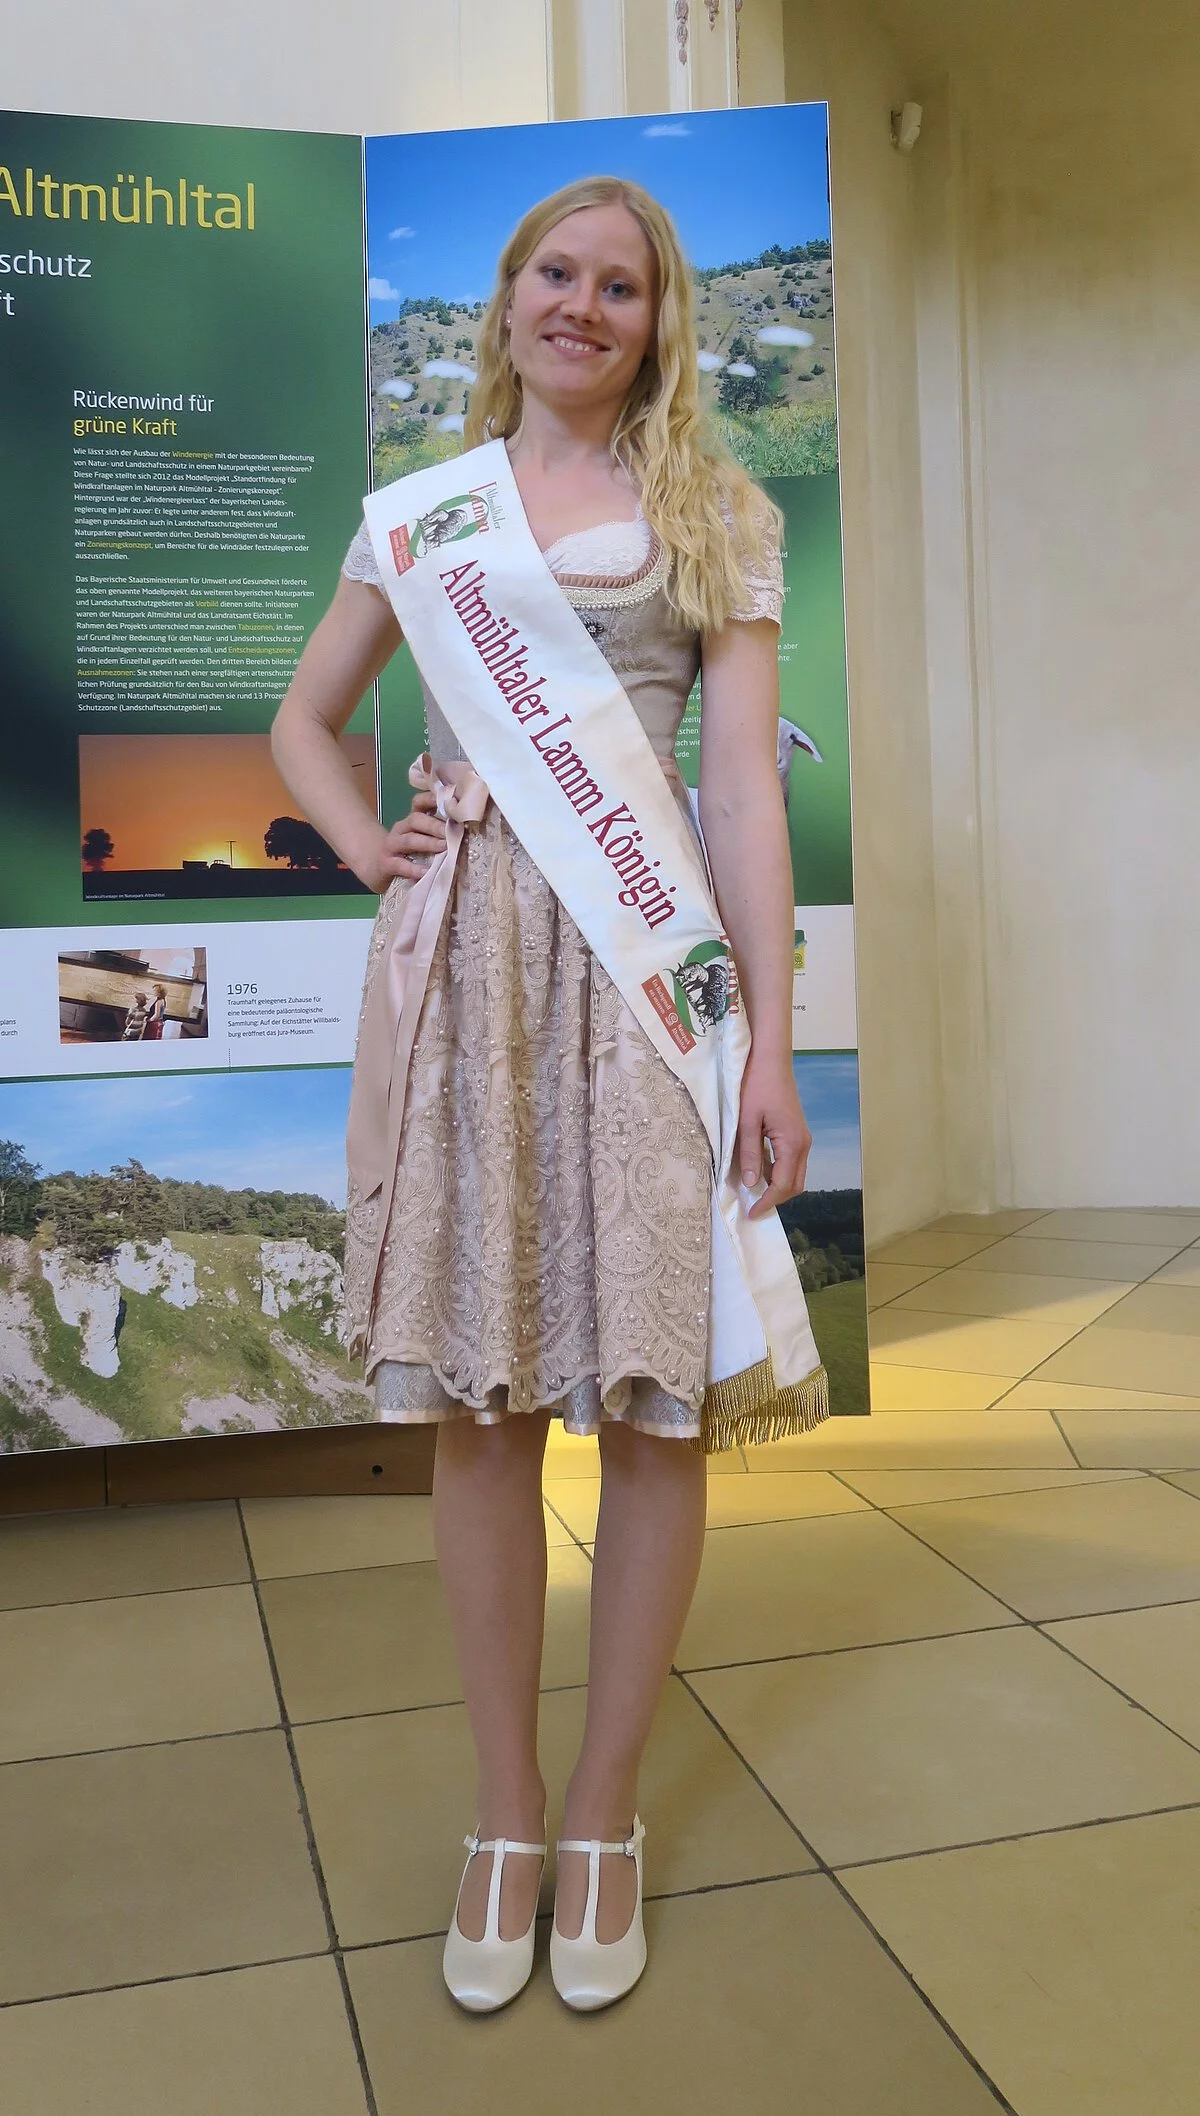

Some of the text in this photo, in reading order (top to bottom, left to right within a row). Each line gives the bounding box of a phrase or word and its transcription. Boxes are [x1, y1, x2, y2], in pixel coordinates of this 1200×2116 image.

[73, 390, 215, 412] Rückenwind für
[73, 416, 177, 437] grüne Kraft
[440, 560, 677, 930] Altmühltaler Lamm Königin
[227, 983, 258, 995] 1976
